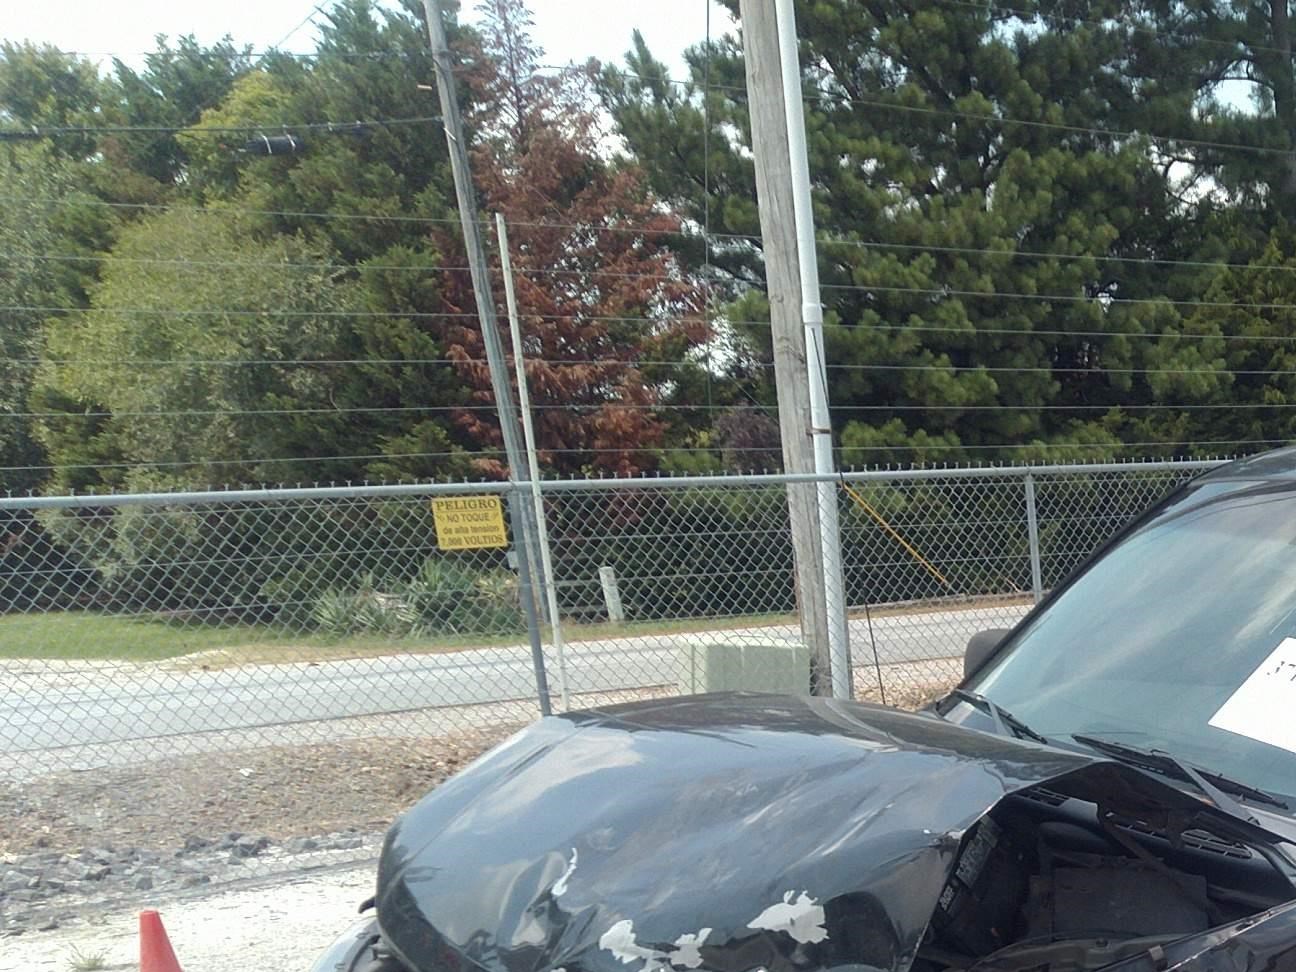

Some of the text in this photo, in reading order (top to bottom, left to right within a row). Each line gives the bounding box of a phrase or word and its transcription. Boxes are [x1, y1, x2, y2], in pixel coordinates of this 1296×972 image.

[435, 499, 497, 511] PELIGRO
[447, 512, 490, 522] NO TOQUE
[463, 535, 504, 545] VOLTIOS
